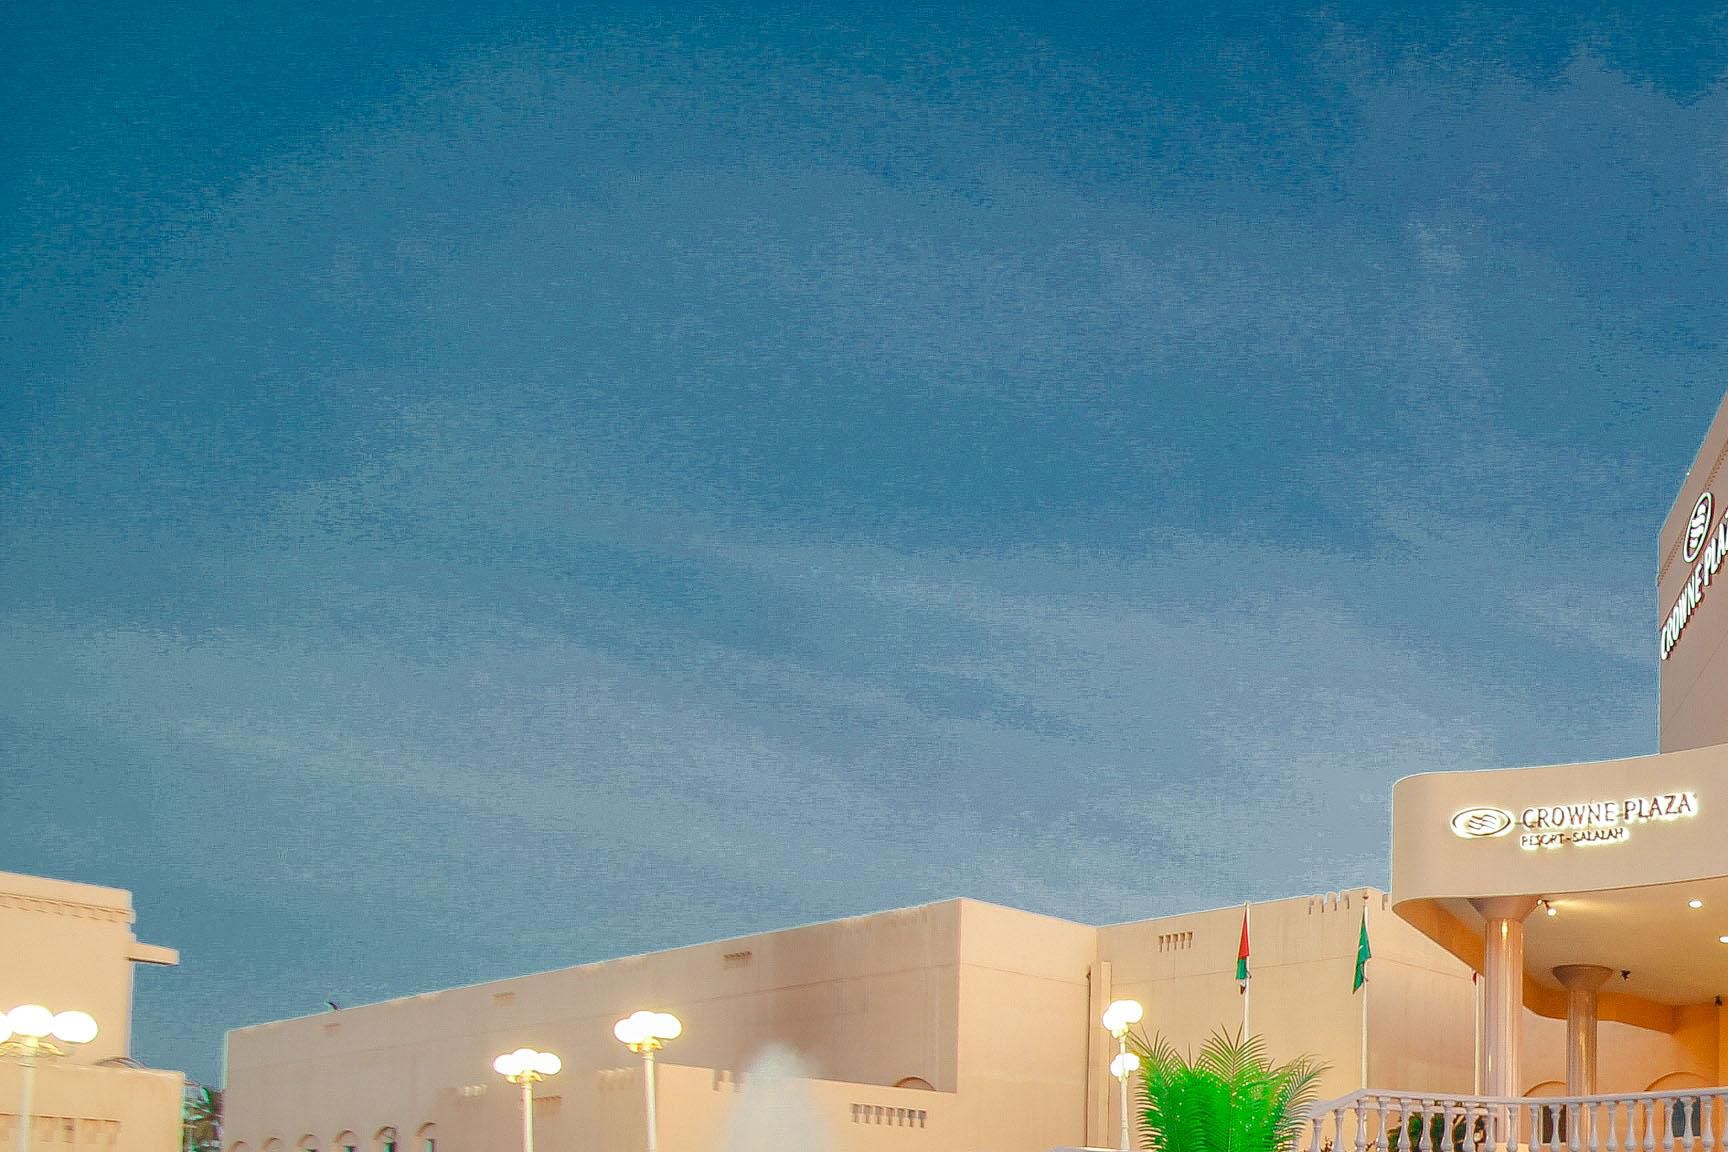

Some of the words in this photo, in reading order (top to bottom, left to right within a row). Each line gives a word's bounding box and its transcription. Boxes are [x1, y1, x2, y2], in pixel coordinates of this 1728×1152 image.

[1660, 563, 1703, 660] CROWNE
[1522, 802, 1616, 829] CROWNE
[1624, 793, 1692, 820] PLAZA
